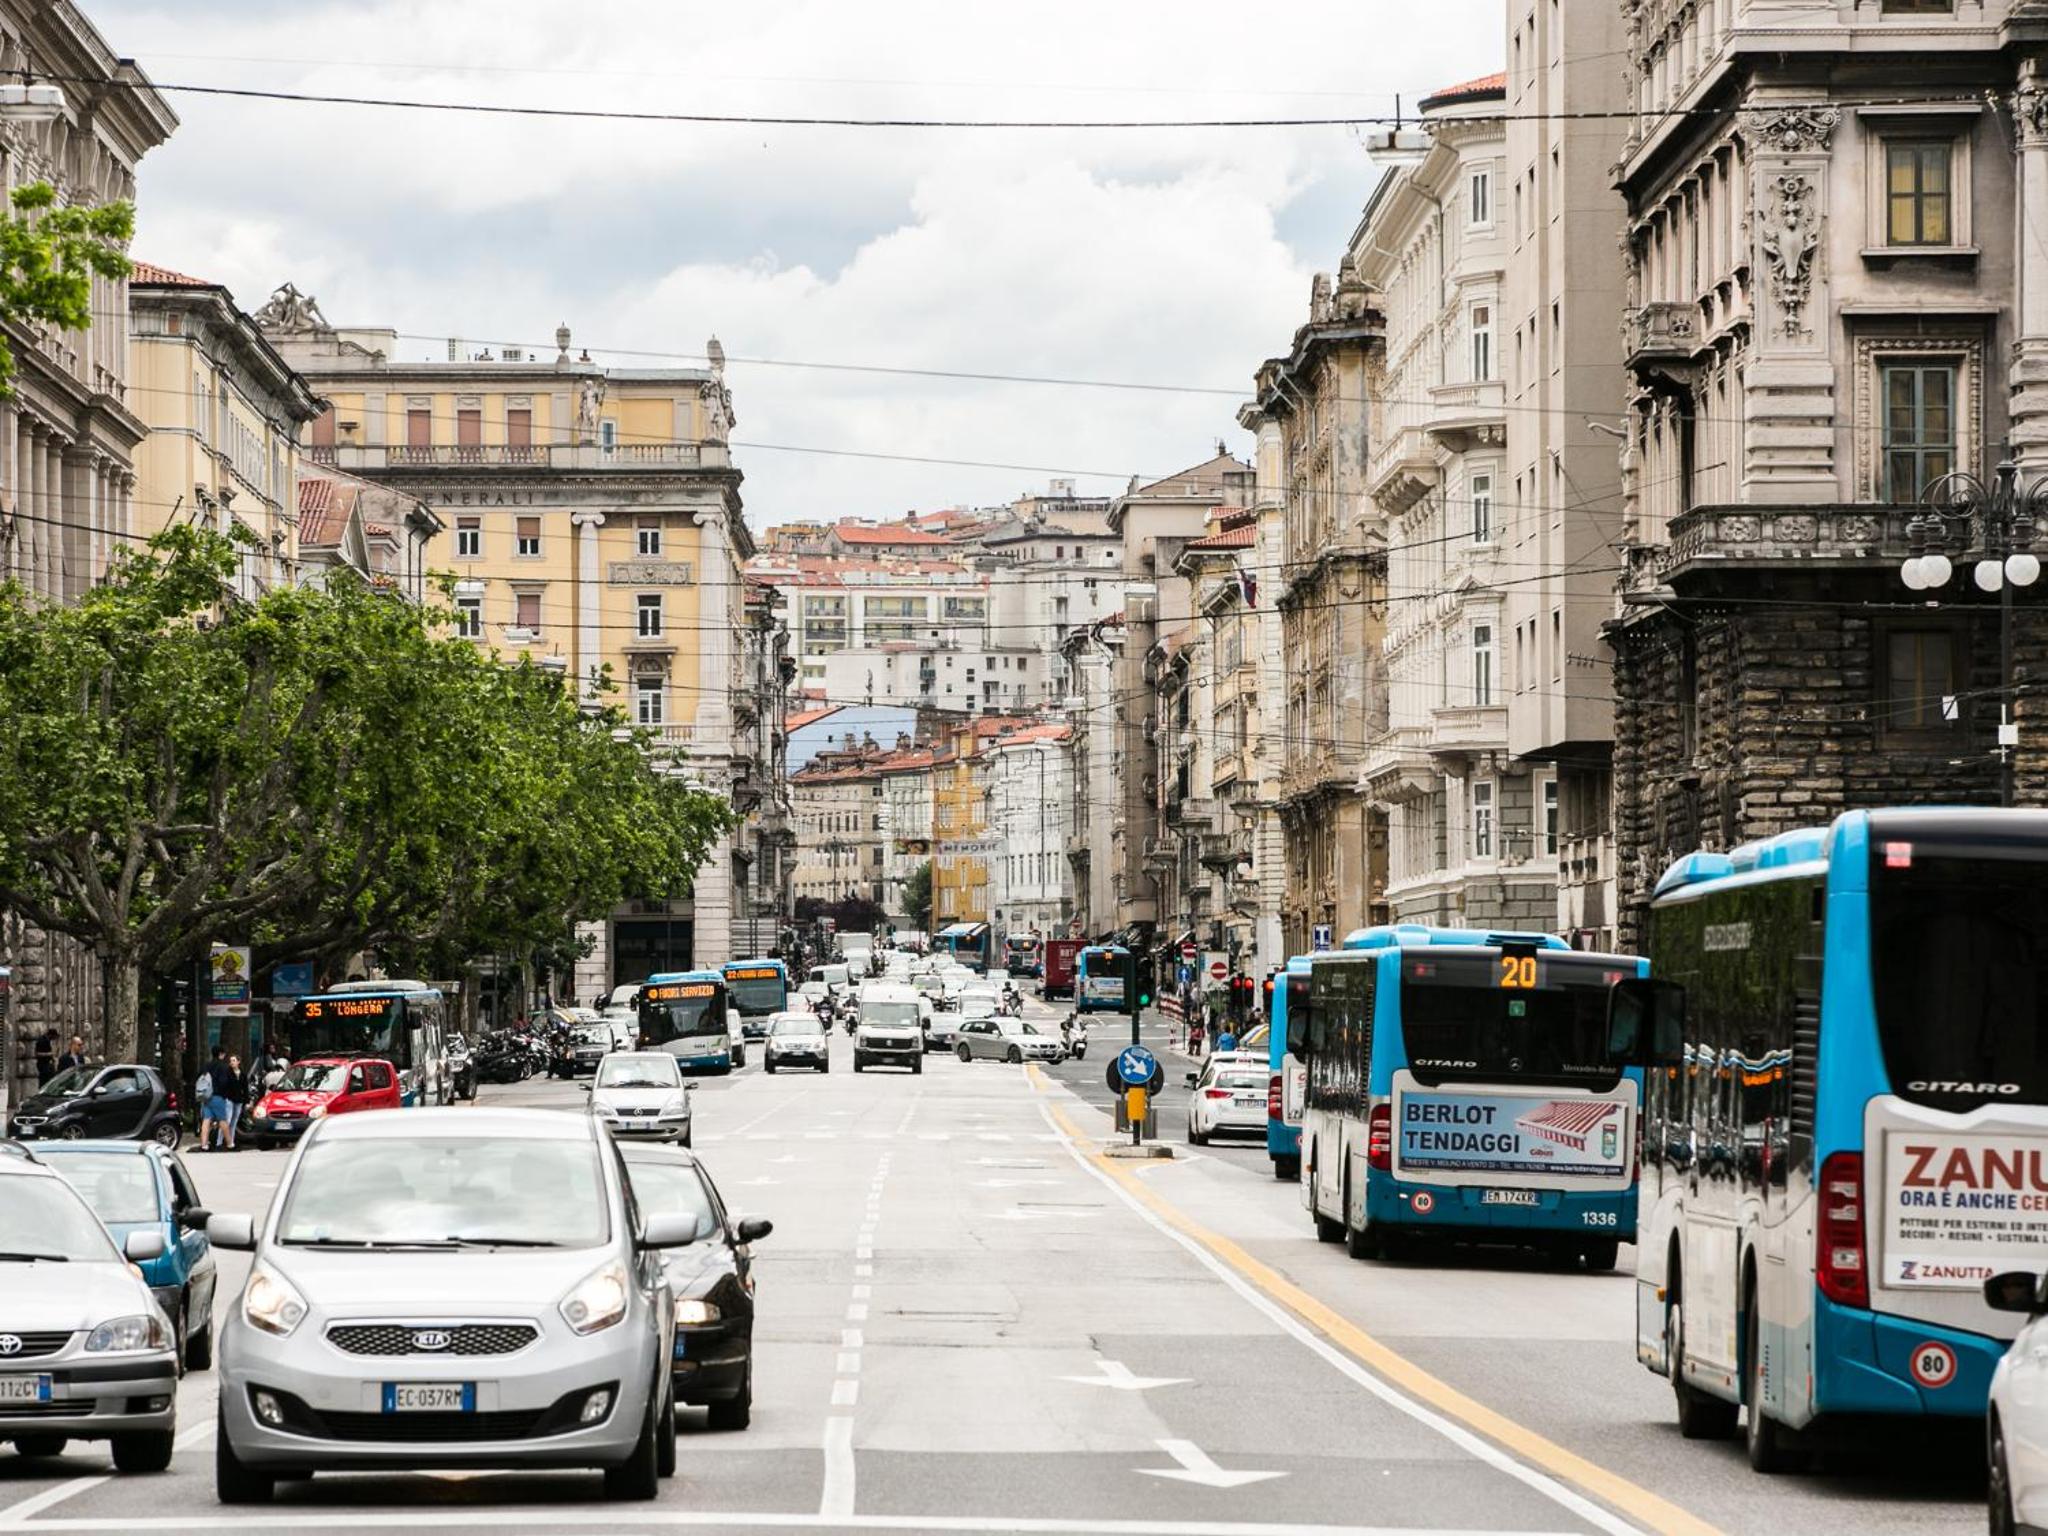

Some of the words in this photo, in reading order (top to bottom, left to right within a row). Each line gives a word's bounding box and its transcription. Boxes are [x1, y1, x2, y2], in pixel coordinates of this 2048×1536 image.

[411, 492, 533, 505] ENERALI
[1501, 956, 1537, 988] 20
[305, 1003, 322, 1017] 35
[338, 1004, 384, 1016] LONGERA
[1415, 1058, 1478, 1068] CITARO
[1907, 1081, 2021, 1095] CITARO
[1406, 1103, 1497, 1125] BERLOT
[1404, 1130, 1520, 1154] TENDAGGI
[1901, 1190, 1937, 1207] ORA
[1956, 1193, 2018, 1210] ANCHE
[1582, 1211, 1617, 1226] 1336
[1900, 1218, 1939, 1228] PITTURE
[1944, 1219, 1963, 1229] PER
[1966, 1220, 2007, 1230] ESTERNI
[1900, 1230, 1936, 1239] DECORI
[1948, 1232, 1983, 1241] RESINE
[1997, 1234, 2039, 1244] SISTEMA
[1922, 1265, 1994, 1279] ZANUTTA
[418, 1334, 445, 1345] KIA
[1922, 1355, 1944, 1373] 80
